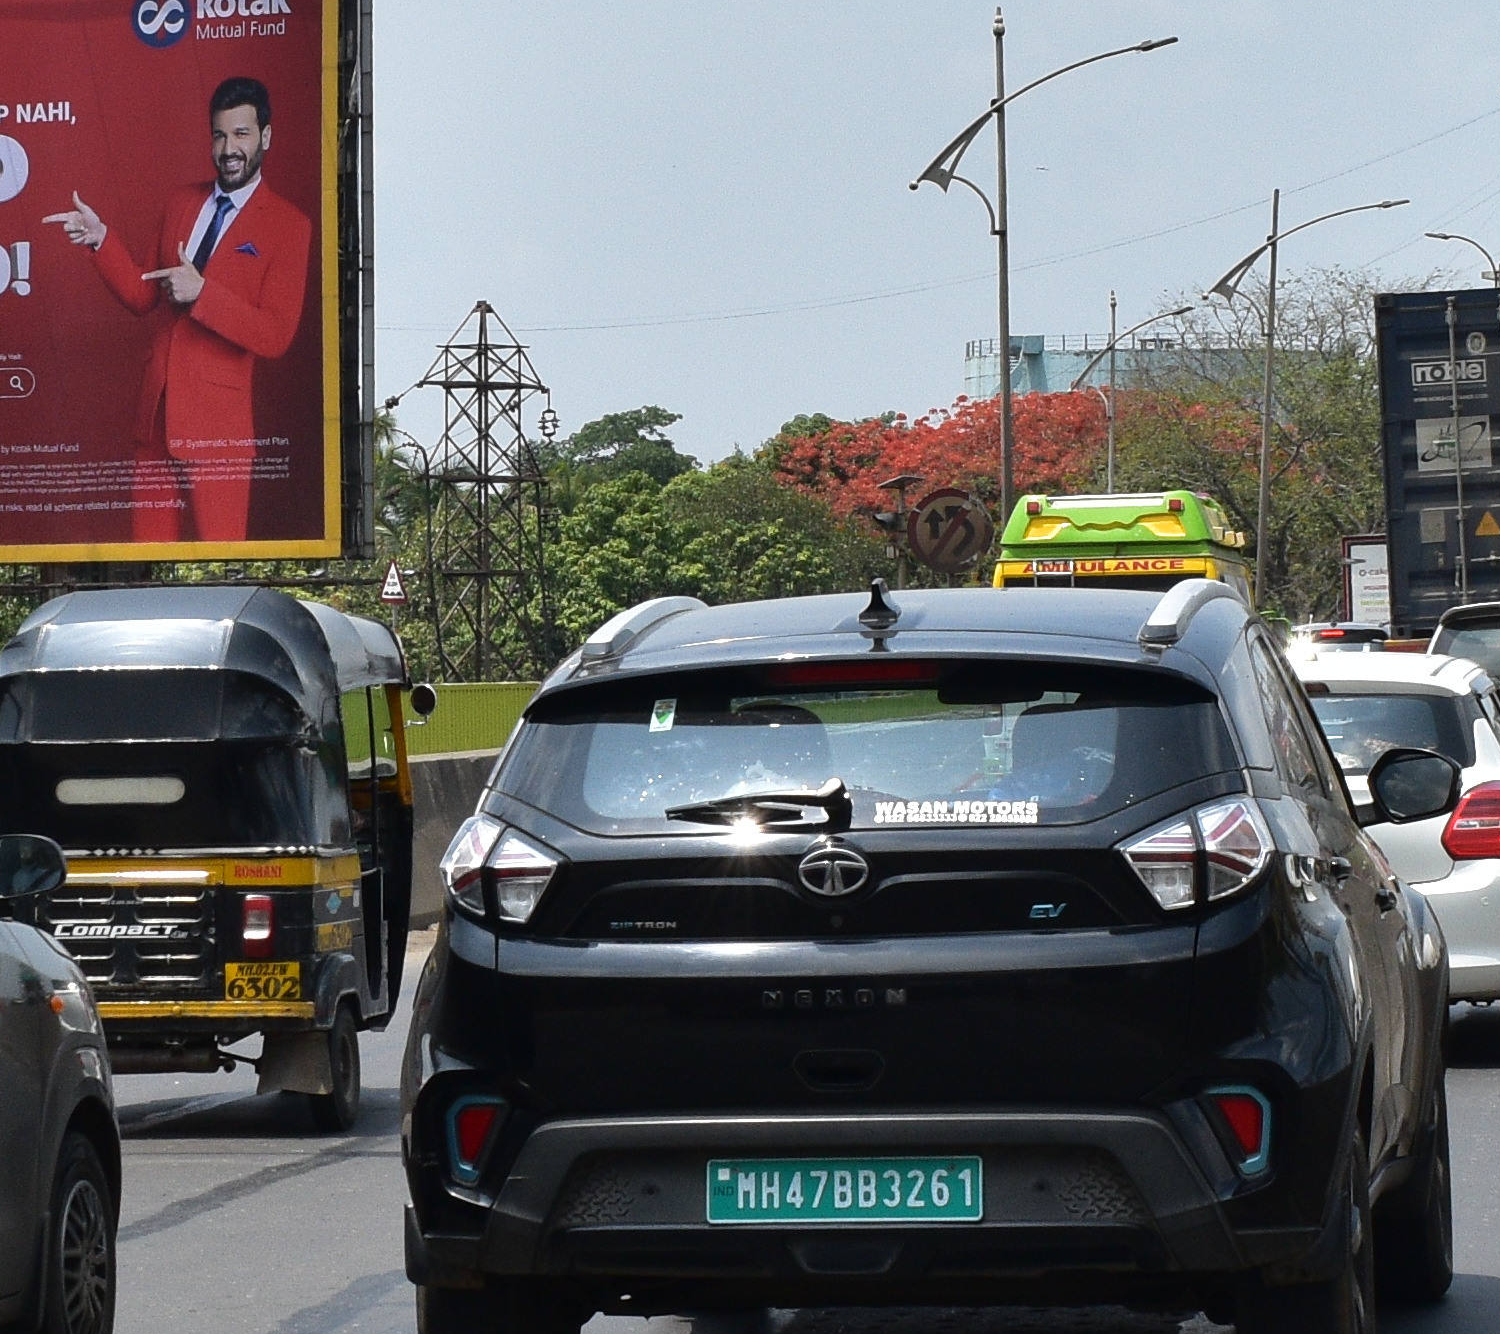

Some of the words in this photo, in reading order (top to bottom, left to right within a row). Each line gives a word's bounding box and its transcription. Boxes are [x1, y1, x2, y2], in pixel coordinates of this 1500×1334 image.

[196, 21, 246, 40] Mutual
[250, 18, 285, 37] Fund
[16, 101, 76, 125] NAHI,
[60, 443, 79, 452] Fund
[186, 439, 228, 450] Systematic
[229, 437, 271, 448] Investment
[272, 436, 289, 446] Plan
[25, 502, 42, 511] read
[84, 500, 110, 510] related
[110, 499, 153, 509] documents
[1022, 558, 1185, 573] AMBULANCE
[875, 800, 948, 816] WASAN
[953, 800, 1038, 815] MOTORS
[1029, 902, 1068, 919] EV
[610, 920, 677, 930] ZIPTRON
[227, 976, 298, 1000] 6302
[762, 988, 907, 1007] NEXON
[713, 1185, 735, 1198] IND
[737, 1168, 973, 1209] MH47BB3261
